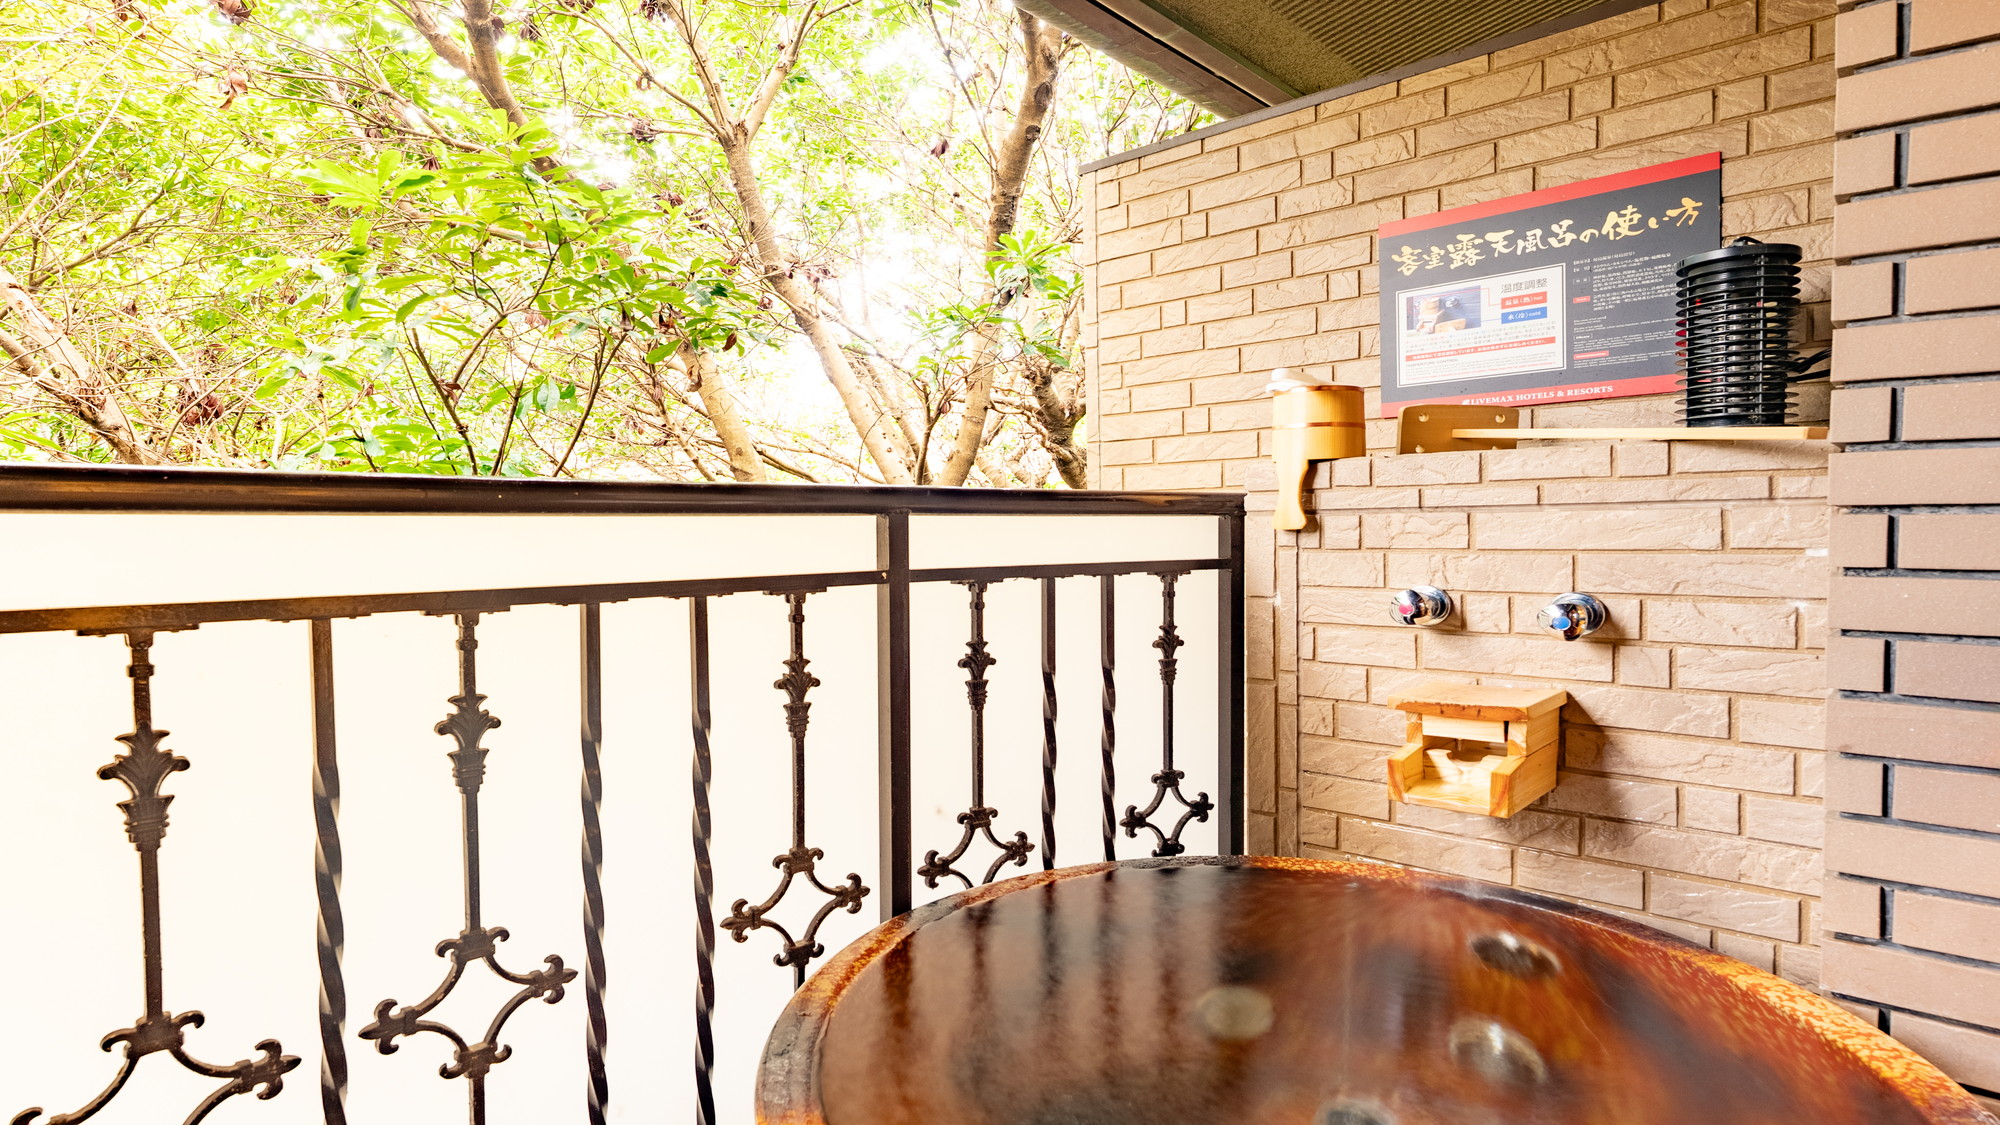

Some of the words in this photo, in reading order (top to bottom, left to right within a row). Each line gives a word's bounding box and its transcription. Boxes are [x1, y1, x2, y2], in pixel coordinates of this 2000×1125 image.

[1391, 197, 1703, 276] 客室露天風呂の使い方
[1501, 278, 1548, 293] 温度調整
[1516, 391, 1555, 401] HOTELS
[1556, 390, 1564, 398] &
[1566, 385, 1614, 396] RESORTS
